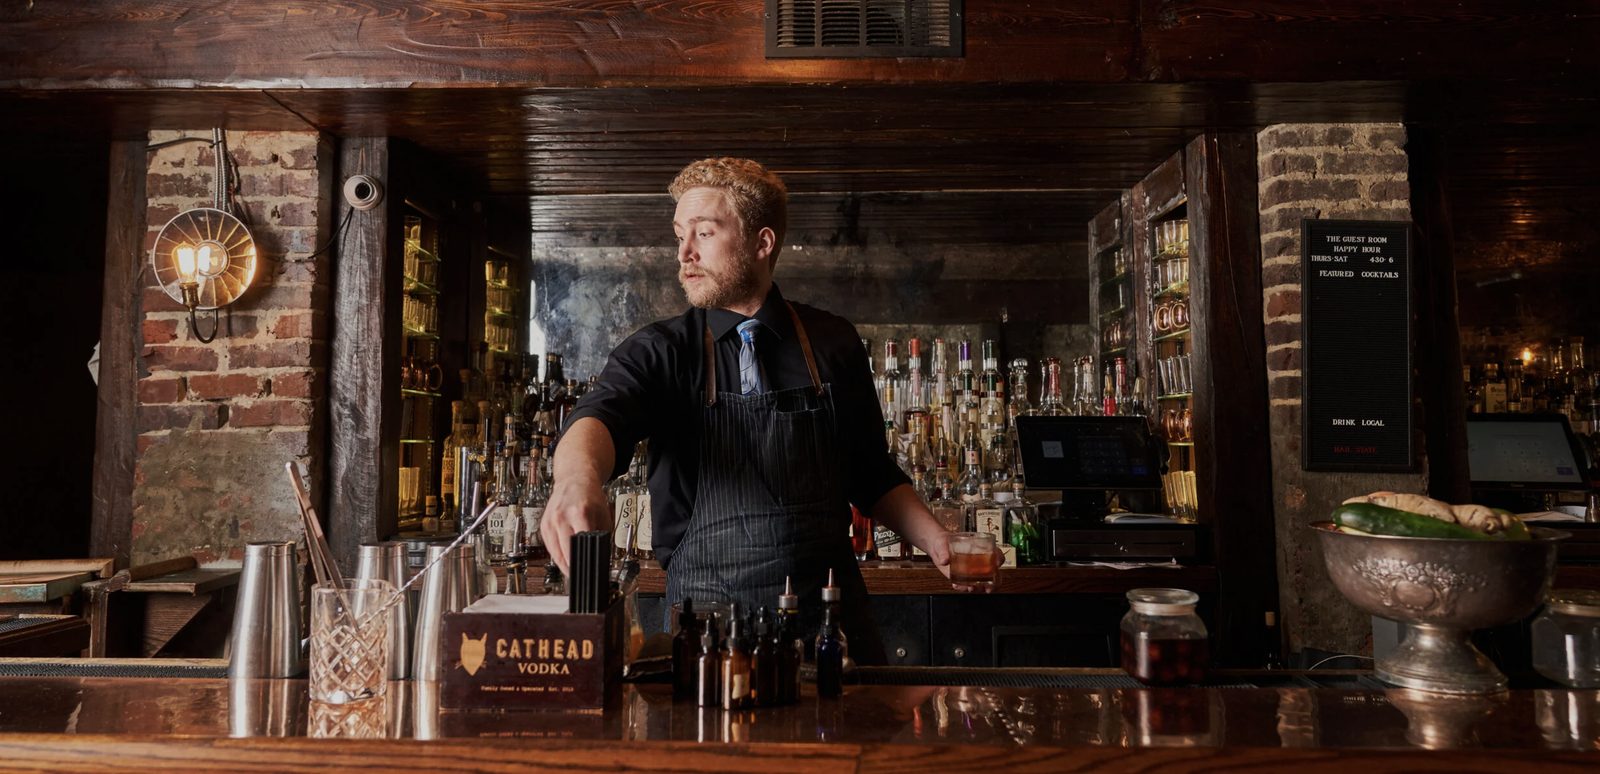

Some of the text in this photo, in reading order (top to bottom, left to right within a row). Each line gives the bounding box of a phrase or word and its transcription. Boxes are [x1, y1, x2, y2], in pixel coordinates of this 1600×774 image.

[1326, 235, 1341, 243] THE
[1368, 236, 1388, 244] ROOM
[1362, 246, 1381, 254] HOUR
[1388, 256, 1394, 264] 6
[1319, 270, 1399, 279] FEATURED COCKTAILS
[1332, 418, 1385, 427] DRINK LOCAL
[490, 519, 504, 528] 101
[496, 638, 594, 660] CATHEAD
[517, 662, 570, 675] VODKA
